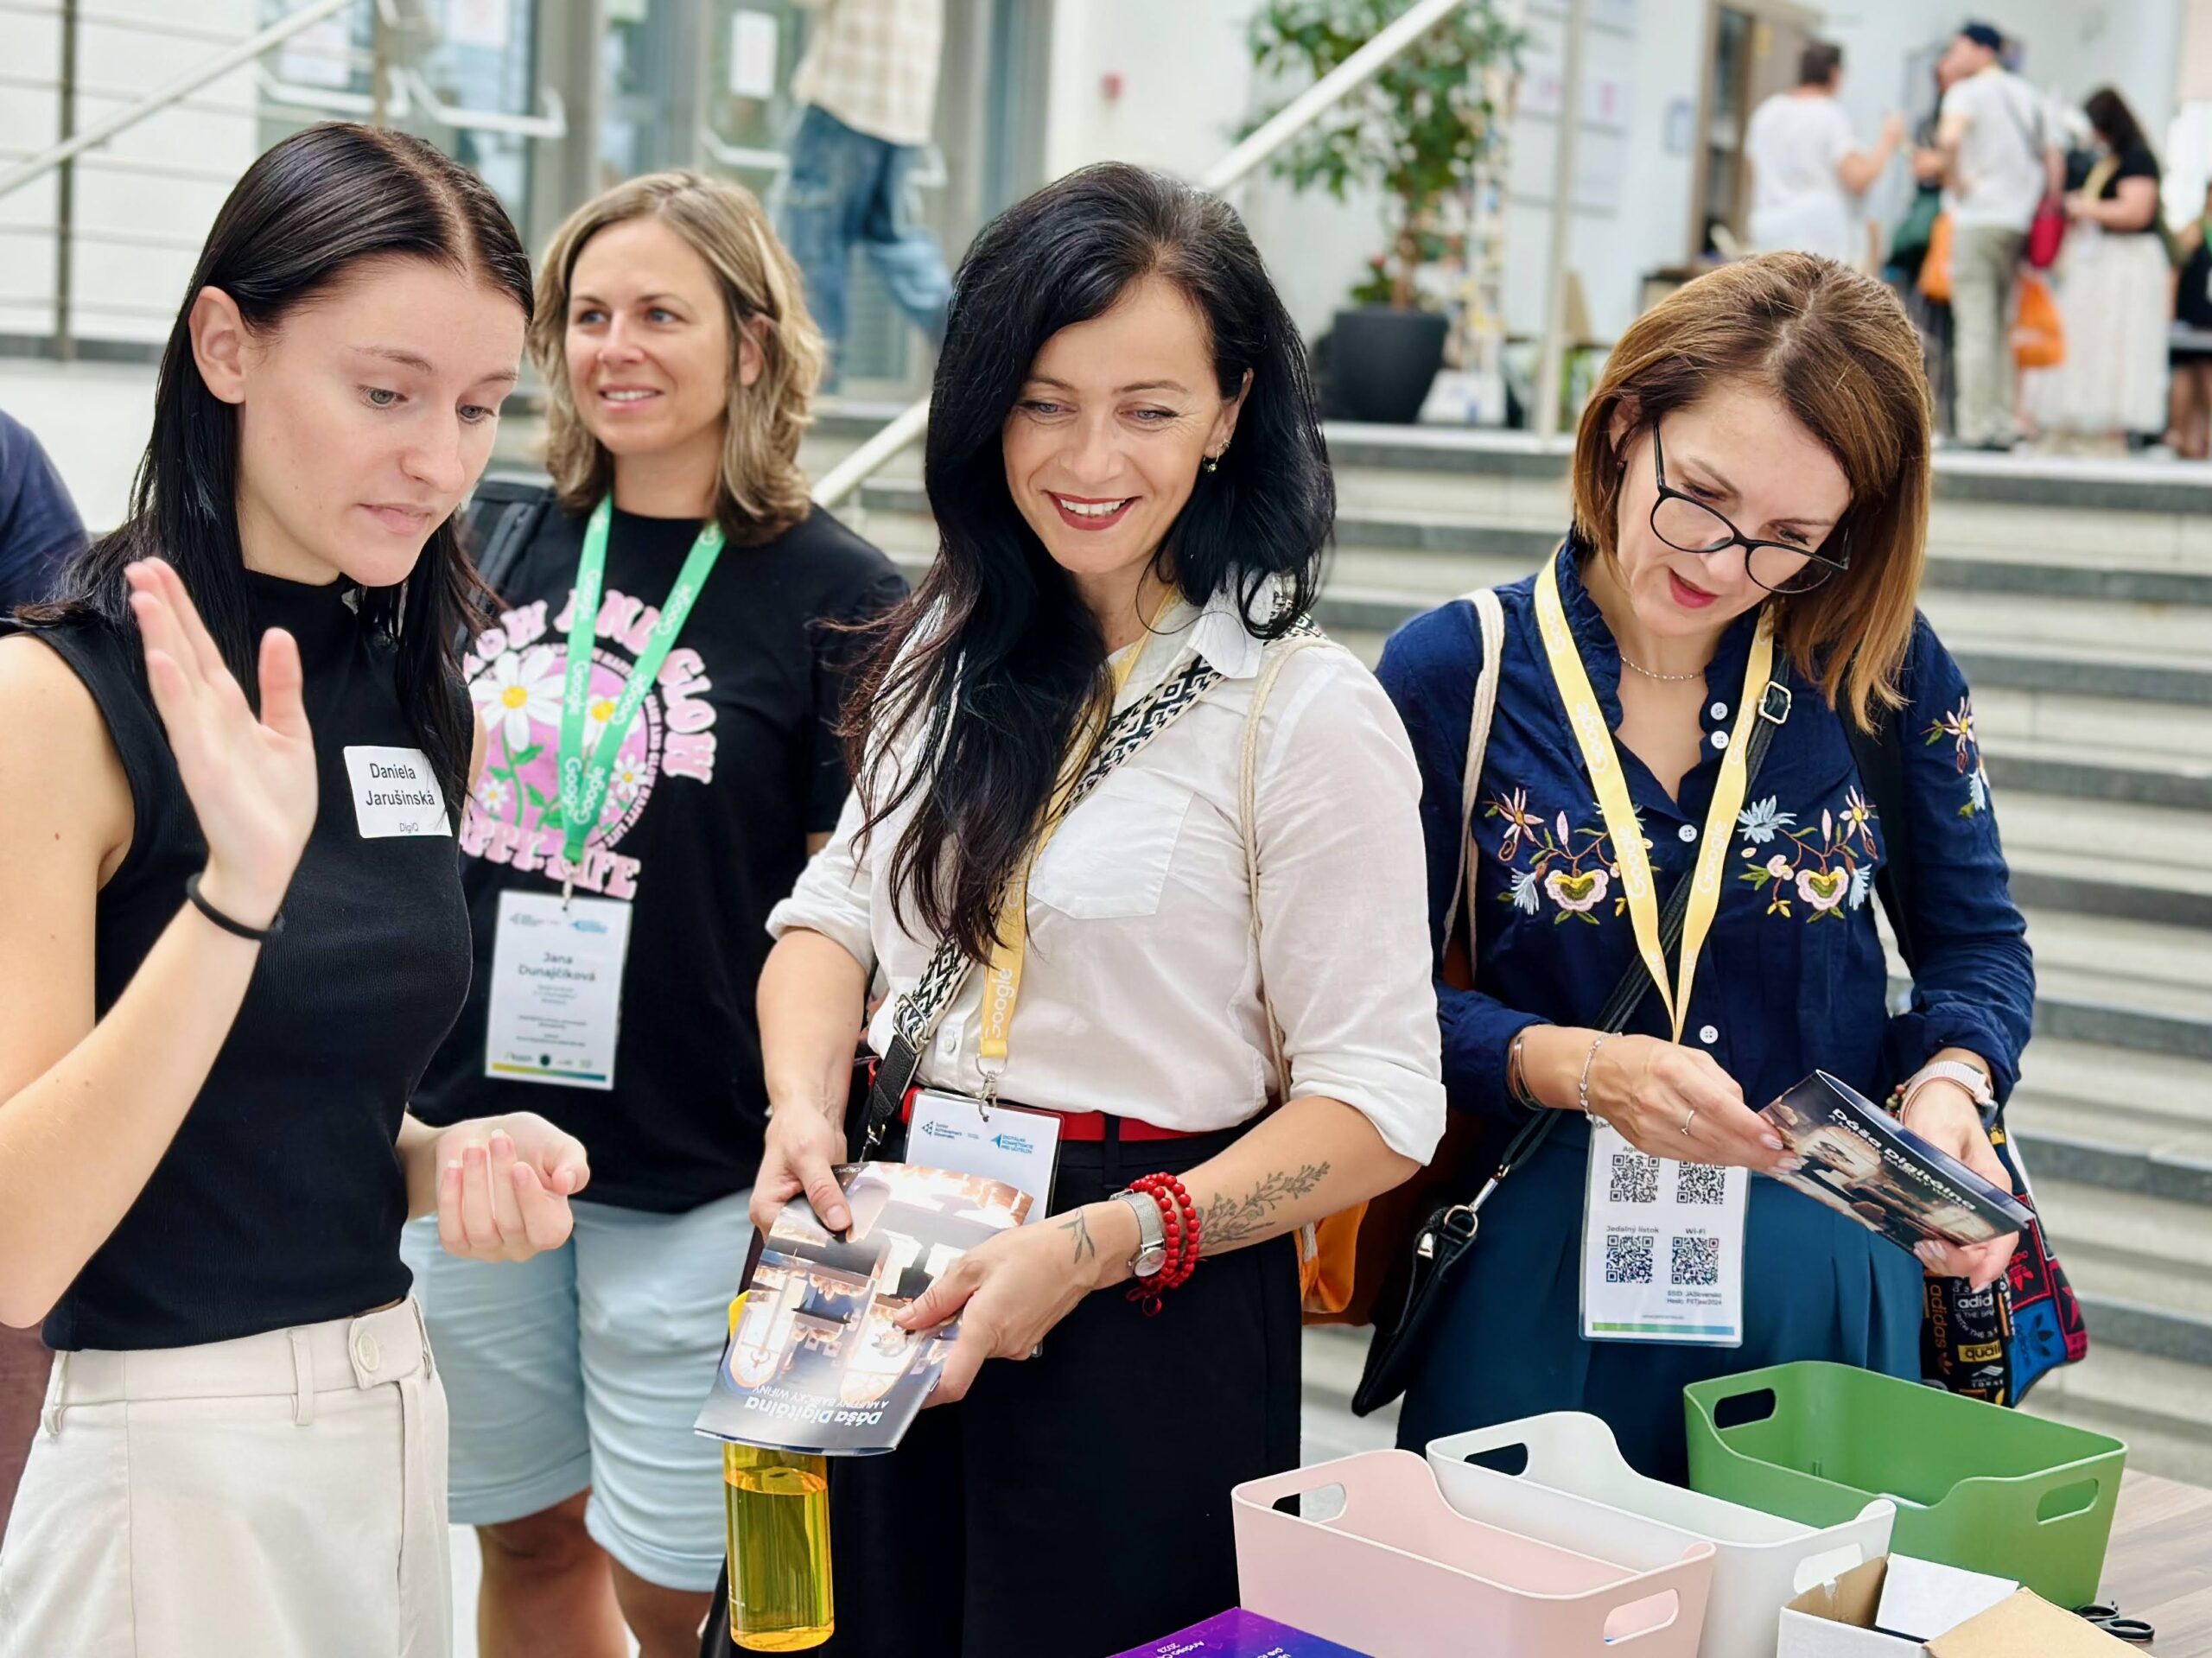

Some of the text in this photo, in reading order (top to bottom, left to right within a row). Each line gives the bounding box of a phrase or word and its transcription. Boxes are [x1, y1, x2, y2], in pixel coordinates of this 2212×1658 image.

[369, 763, 416, 779] Daniela
[365, 790, 435, 806] Jarušinská
[1618, 823, 1648, 899] Google
[1697, 820, 1728, 893] Google
[1958, 1293, 1994, 1309] adid
[1929, 1284, 1948, 1348] adidas
[753, 1385, 790, 1400] WIFINY
[744, 1395, 883, 1426] Dáša Digitálna
